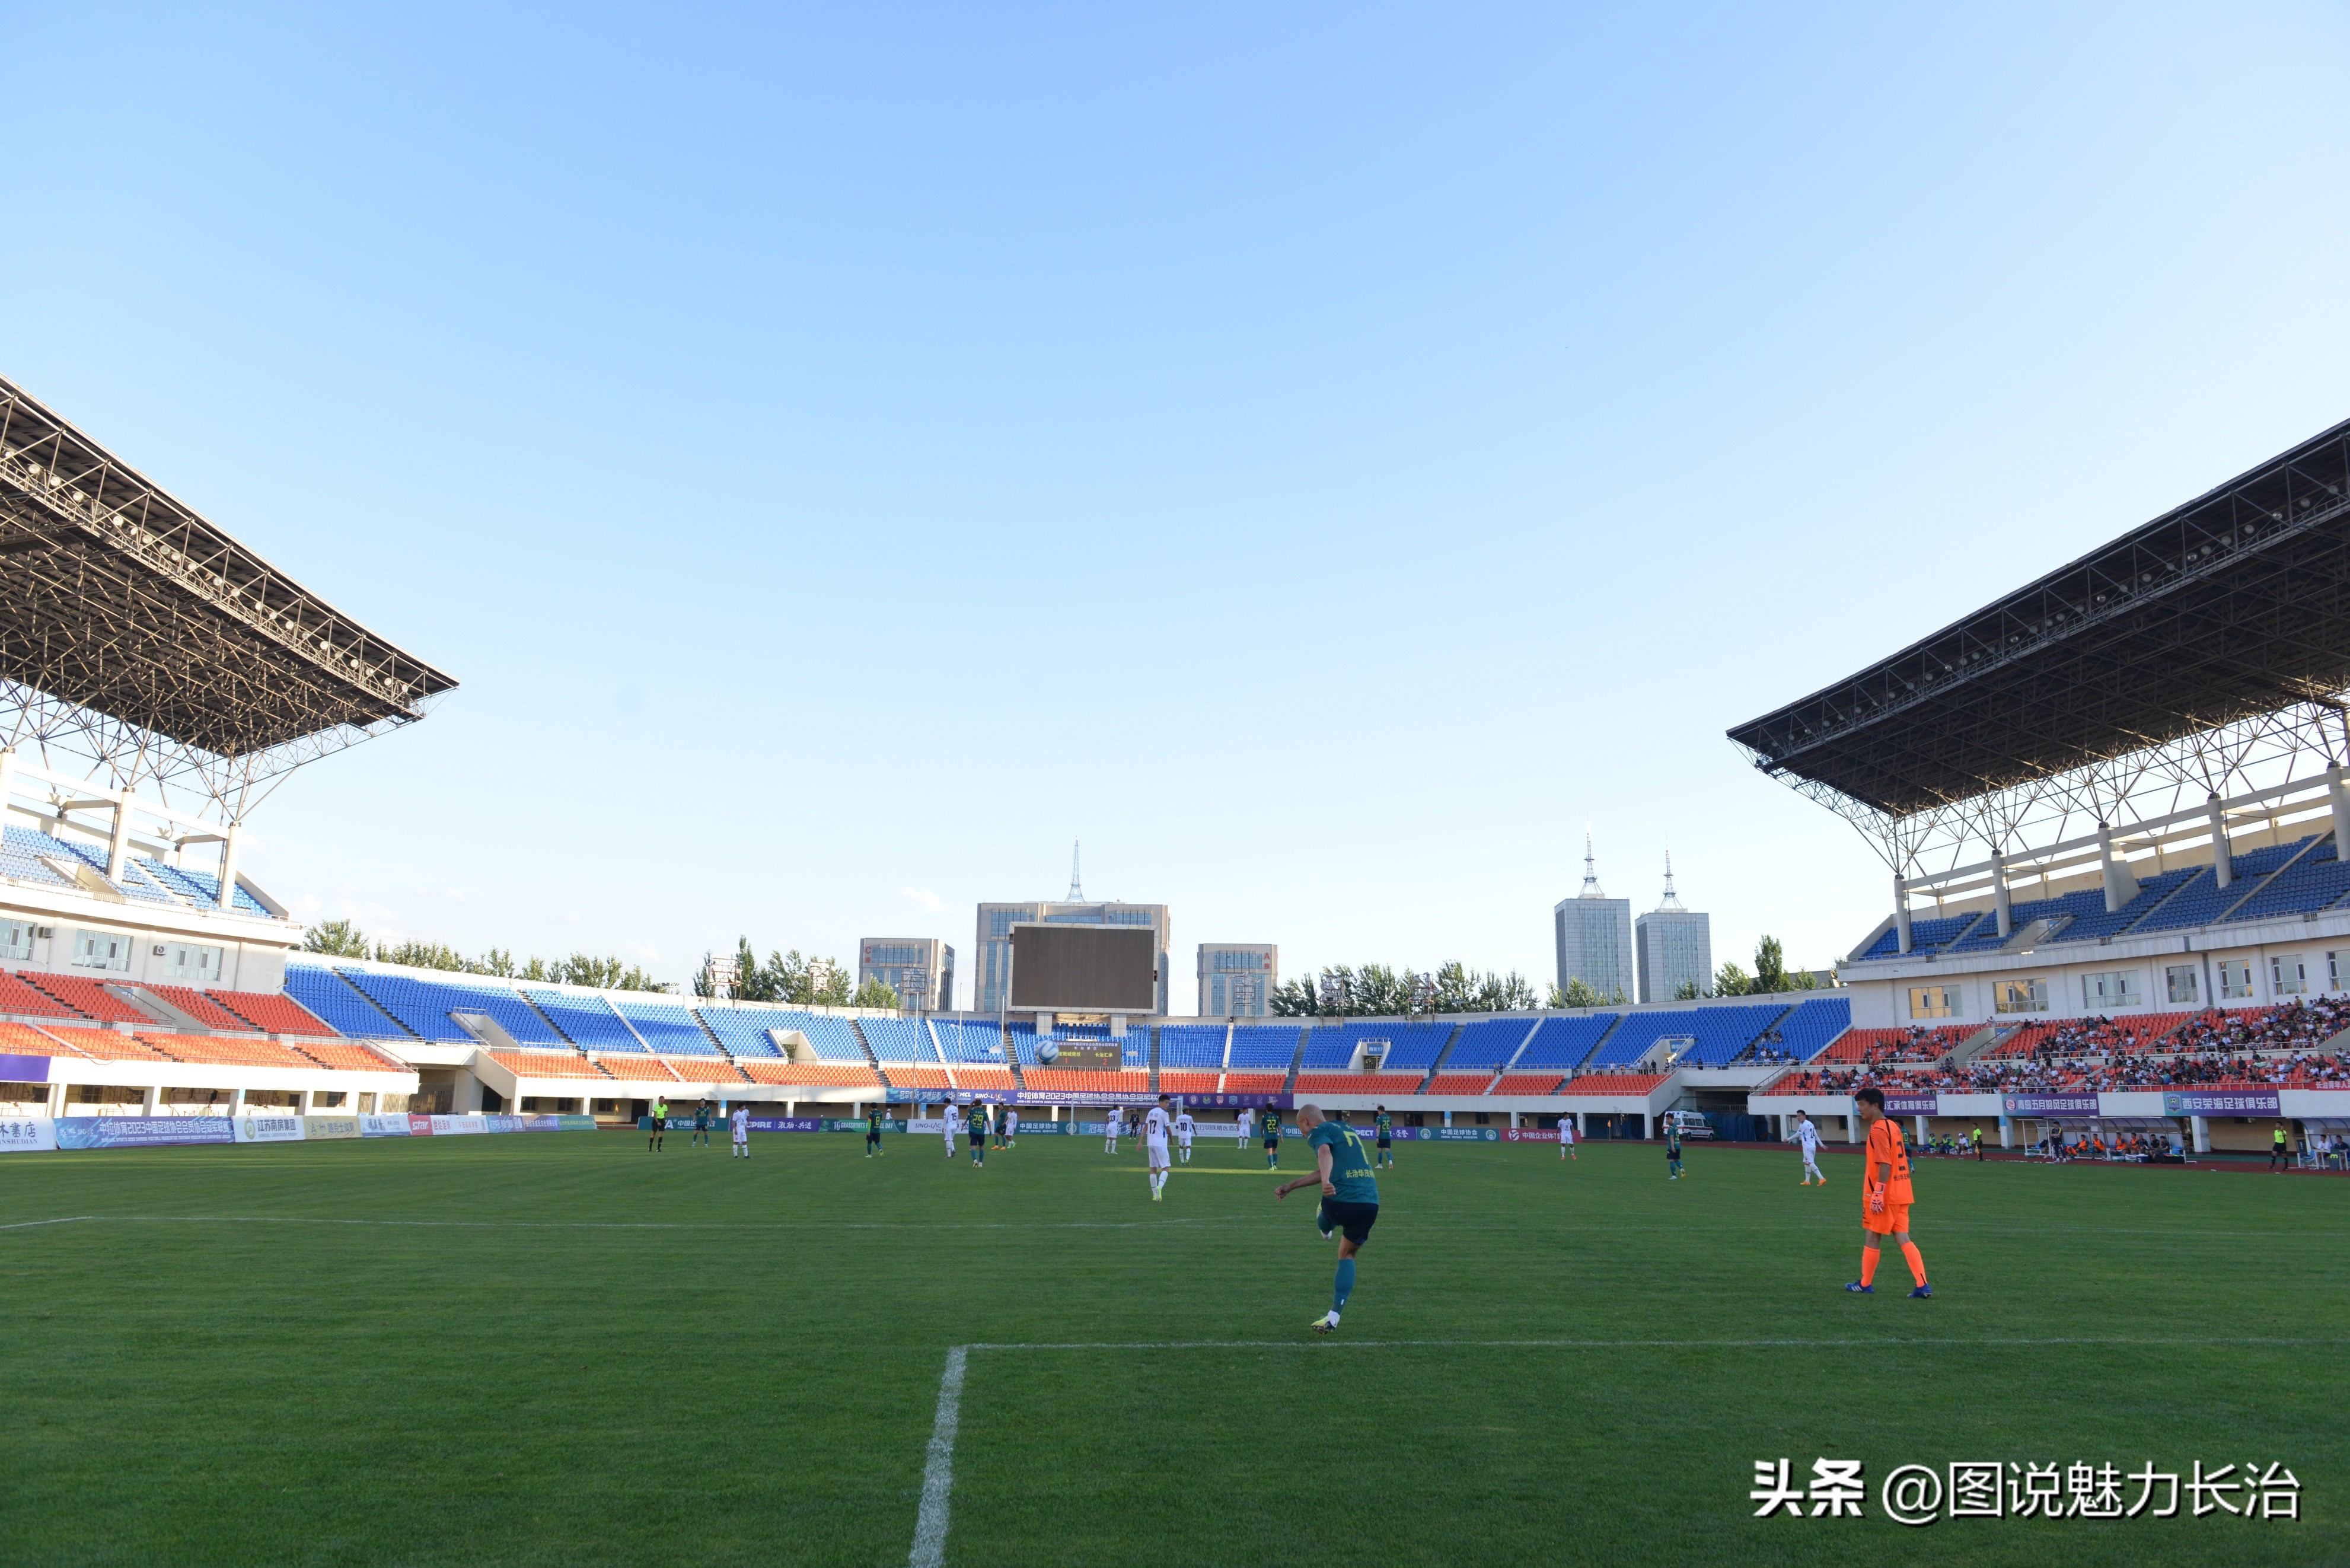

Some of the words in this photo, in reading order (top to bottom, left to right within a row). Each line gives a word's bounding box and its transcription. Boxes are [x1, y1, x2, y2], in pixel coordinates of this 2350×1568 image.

[2017, 1099, 2097, 1110] 青岛五月的风足球俱乐部
[2182, 1097, 2278, 1110] 西安荣海足球俱乐部
[875, 1116, 880, 1126] 8
[972, 1114, 983, 1126] 29
[1267, 1119, 1277, 1130] 22
[1382, 1120, 1390, 1130] 26
[1149, 1119, 1157, 1134] 17
[1179, 1122, 1187, 1131] 10
